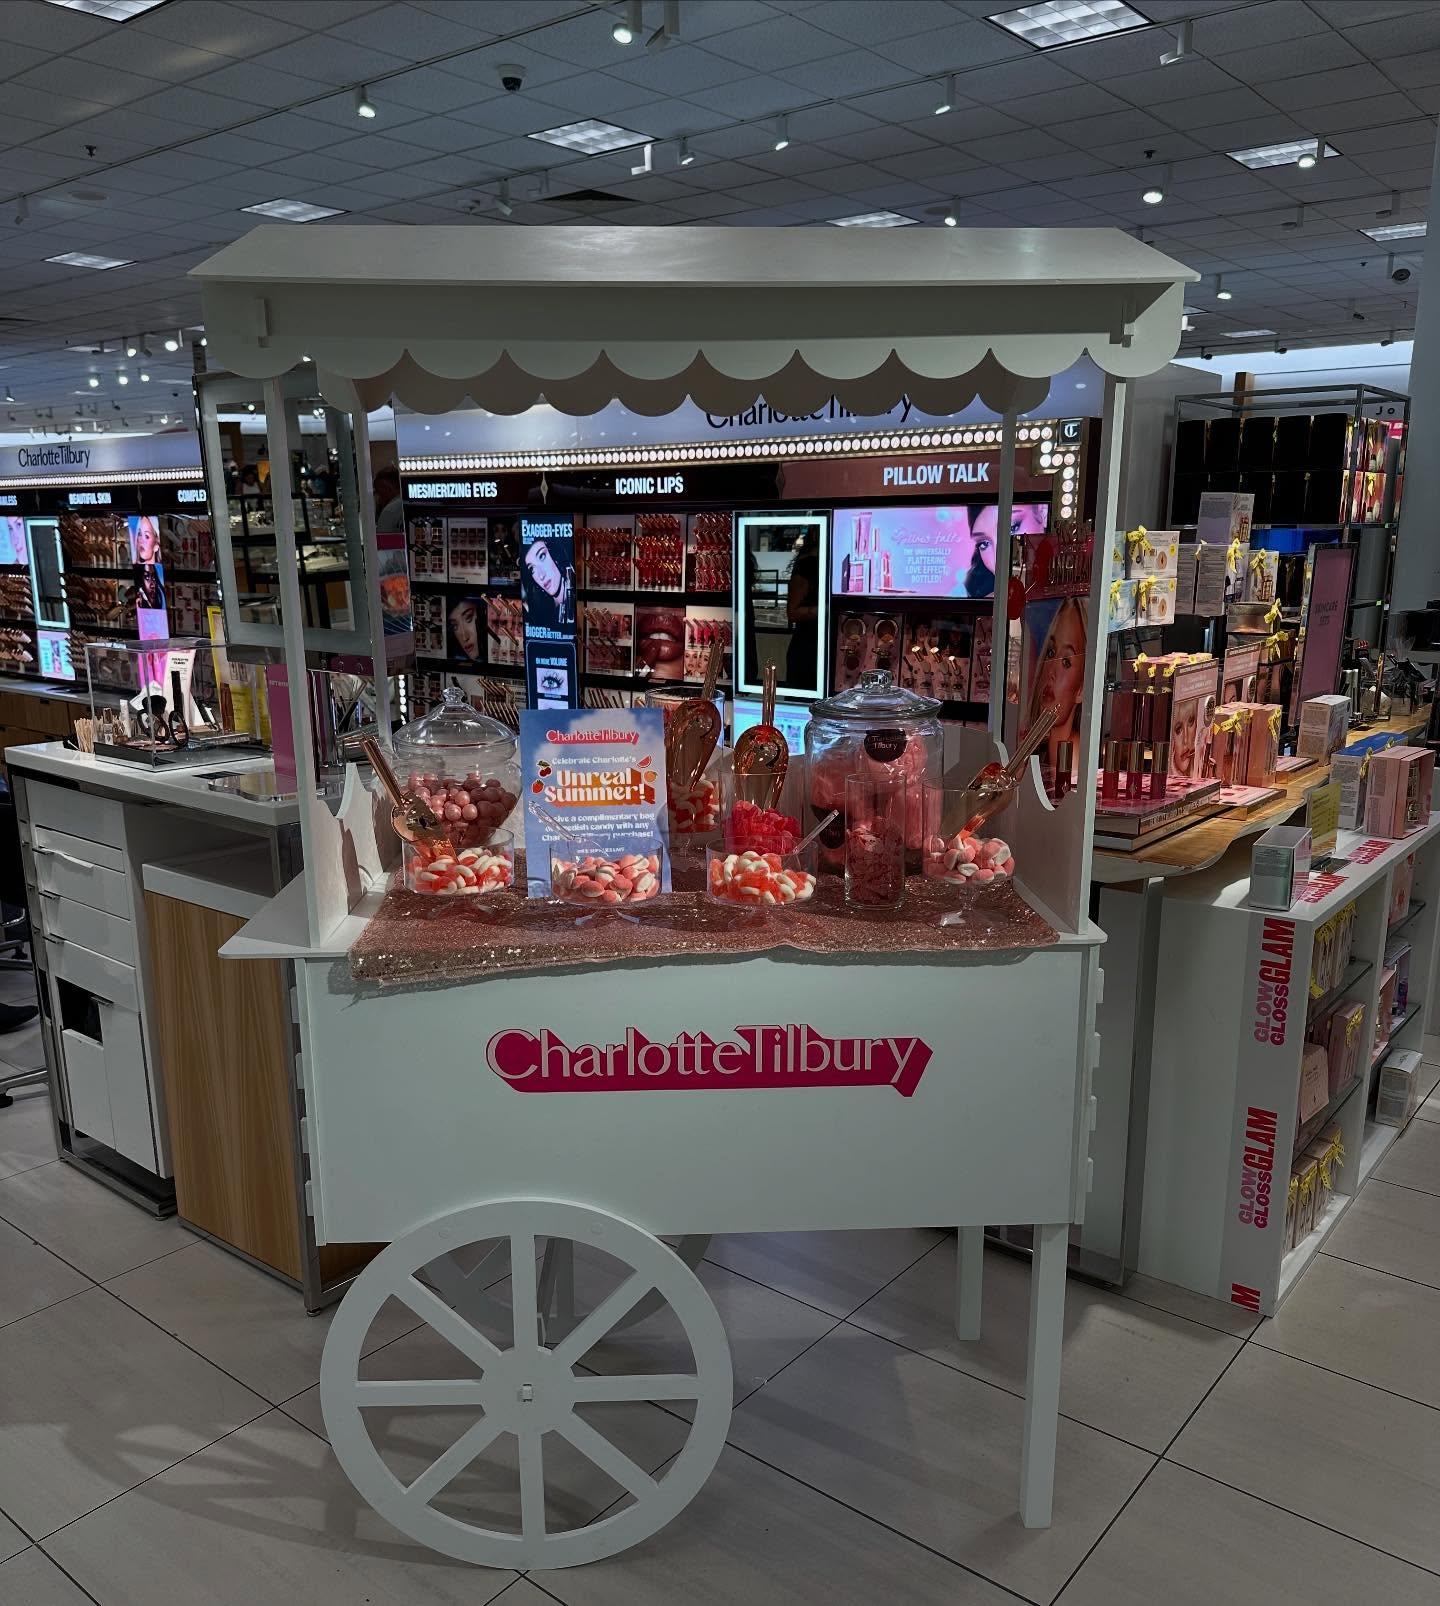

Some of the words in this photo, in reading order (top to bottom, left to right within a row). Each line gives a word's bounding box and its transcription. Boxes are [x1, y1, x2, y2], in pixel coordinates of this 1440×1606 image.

[615, 478, 655, 495] ICONIC
[657, 475, 684, 494] LIPS
[883, 465, 944, 486] PILLOW
[947, 462, 990, 483] TALK
[408, 483, 472, 499] MESMERIZING
[473, 482, 498, 498] EYES
[552, 757, 590, 765] Celebrate
[592, 755, 637, 764] Charlotte's
[557, 767, 632, 787] Unreal
[544, 783, 646, 803] Summer!
[578, 812, 638, 823] complimentary
[616, 822, 633, 830] with
[635, 822, 649, 830] any
[1258, 917, 1296, 985] GLAM
[1254, 979, 1274, 1043] GLOW
[1269, 983, 1289, 1046] GLOSS
[1243, 1106, 1278, 1172] GLAM
[1238, 1164, 1257, 1225] GLOW
[1254, 1169, 1273, 1229] GLOSS
